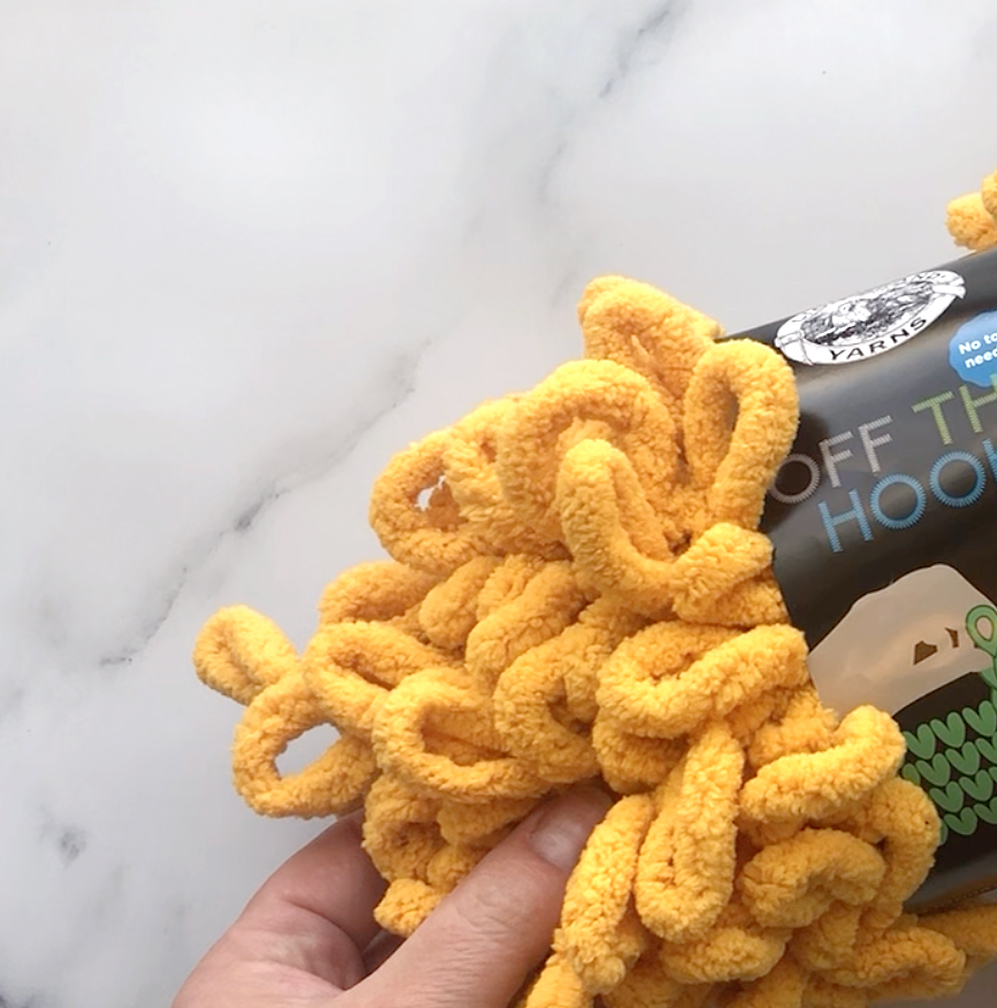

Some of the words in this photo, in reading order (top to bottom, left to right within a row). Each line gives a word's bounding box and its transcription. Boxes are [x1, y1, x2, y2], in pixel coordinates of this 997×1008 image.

[829, 316, 928, 362] YARNS
[958, 339, 981, 355] No
[768, 414, 893, 505] OFF
